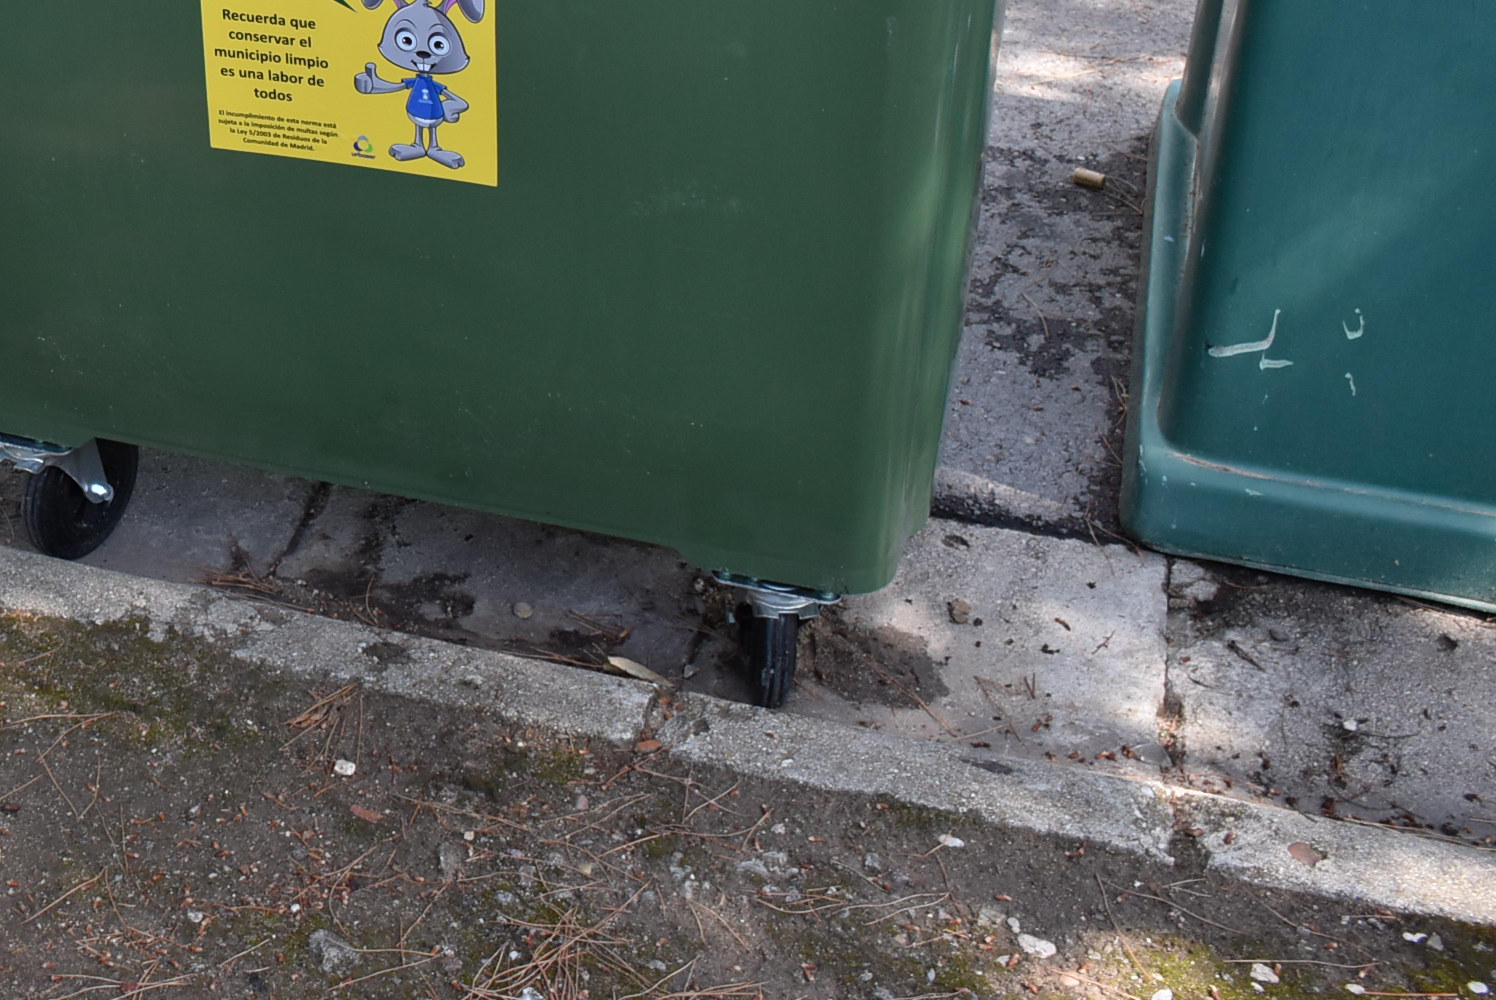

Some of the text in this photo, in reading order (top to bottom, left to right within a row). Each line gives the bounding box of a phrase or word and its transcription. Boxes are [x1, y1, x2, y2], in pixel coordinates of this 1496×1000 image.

[222, 9, 316, 30] Recuerda que
[228, 30, 312, 48] conservar el
[214, 48, 329, 69] municipio limpio
[220, 67, 325, 87] es una labor de
[254, 88, 293, 102] todos
[225, 110, 275, 121] incumplimiento
[236, 128, 248, 136] Ley
[248, 129, 271, 137] 5/2003
[282, 133, 311, 142] Residuos
[251, 121, 285, 131] imposición
[296, 127, 318, 135] multas
[319, 130, 339, 138] según
[242, 137, 279, 147] Comunidad
